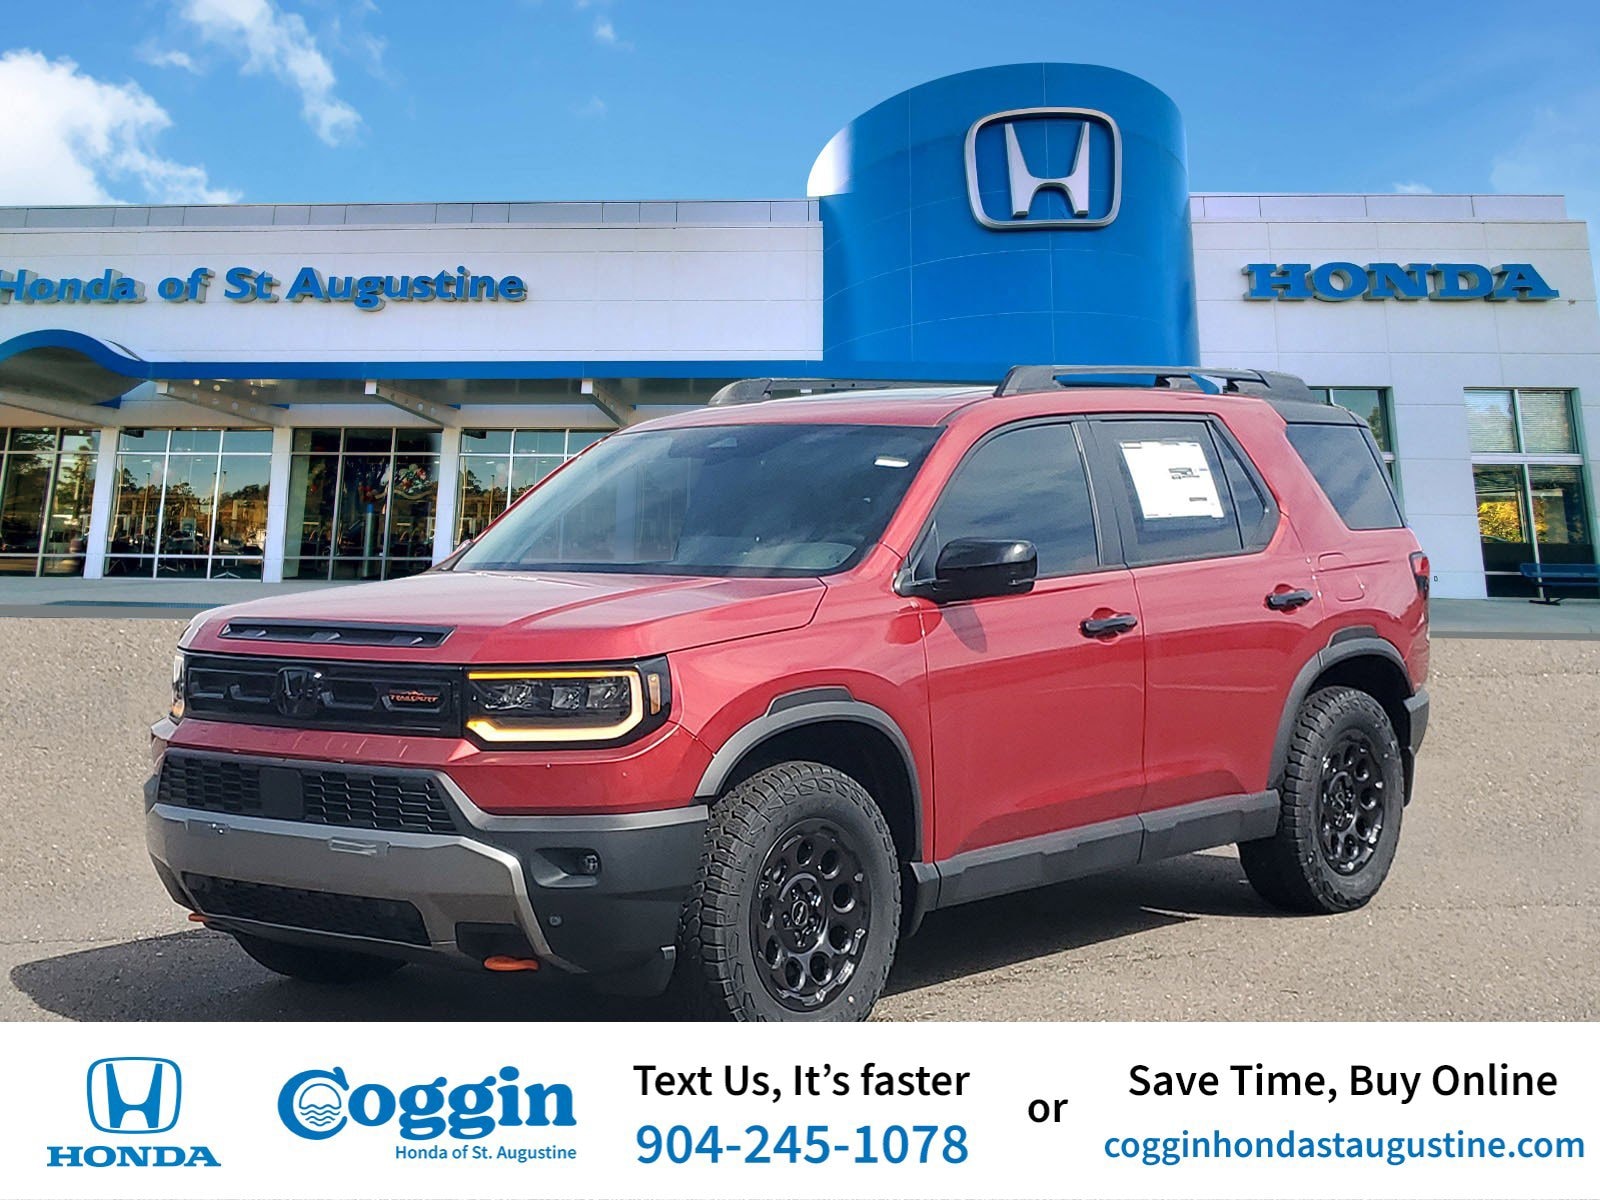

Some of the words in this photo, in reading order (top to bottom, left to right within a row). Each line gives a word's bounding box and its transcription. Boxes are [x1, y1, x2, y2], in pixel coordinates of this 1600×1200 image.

[0, 268, 144, 303] Honda
[157, 267, 213, 302] of
[224, 266, 280, 302] St
[285, 265, 527, 312] Augustine
[1243, 262, 1560, 302] HONDA
